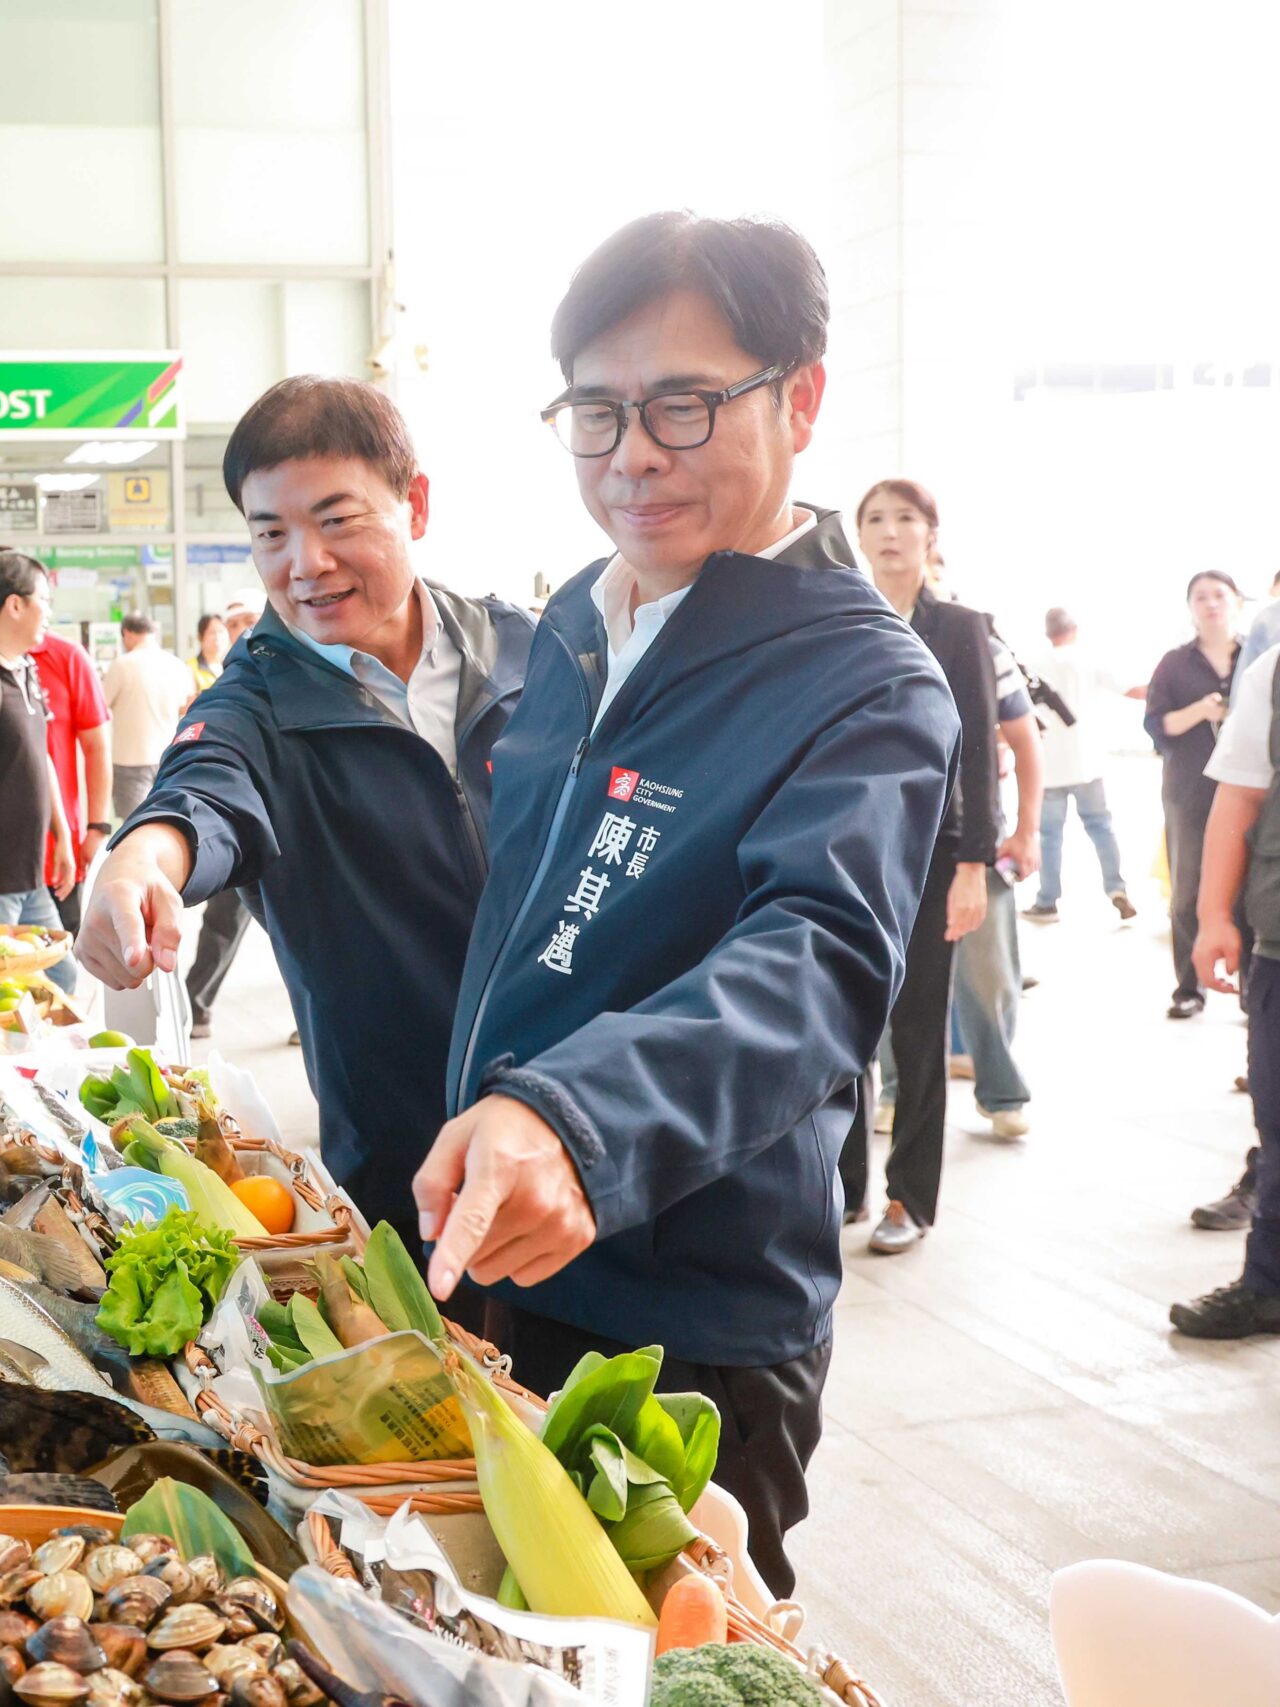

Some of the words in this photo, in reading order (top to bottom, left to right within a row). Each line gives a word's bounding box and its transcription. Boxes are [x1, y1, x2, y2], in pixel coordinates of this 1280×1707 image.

[635, 787, 654, 798] CITY
[638, 778, 684, 799] KAOHSIUNG
[632, 794, 677, 814] GOVERNMENT
[625, 826, 661, 879] 市長
[537, 811, 637, 975] 陳其邁
